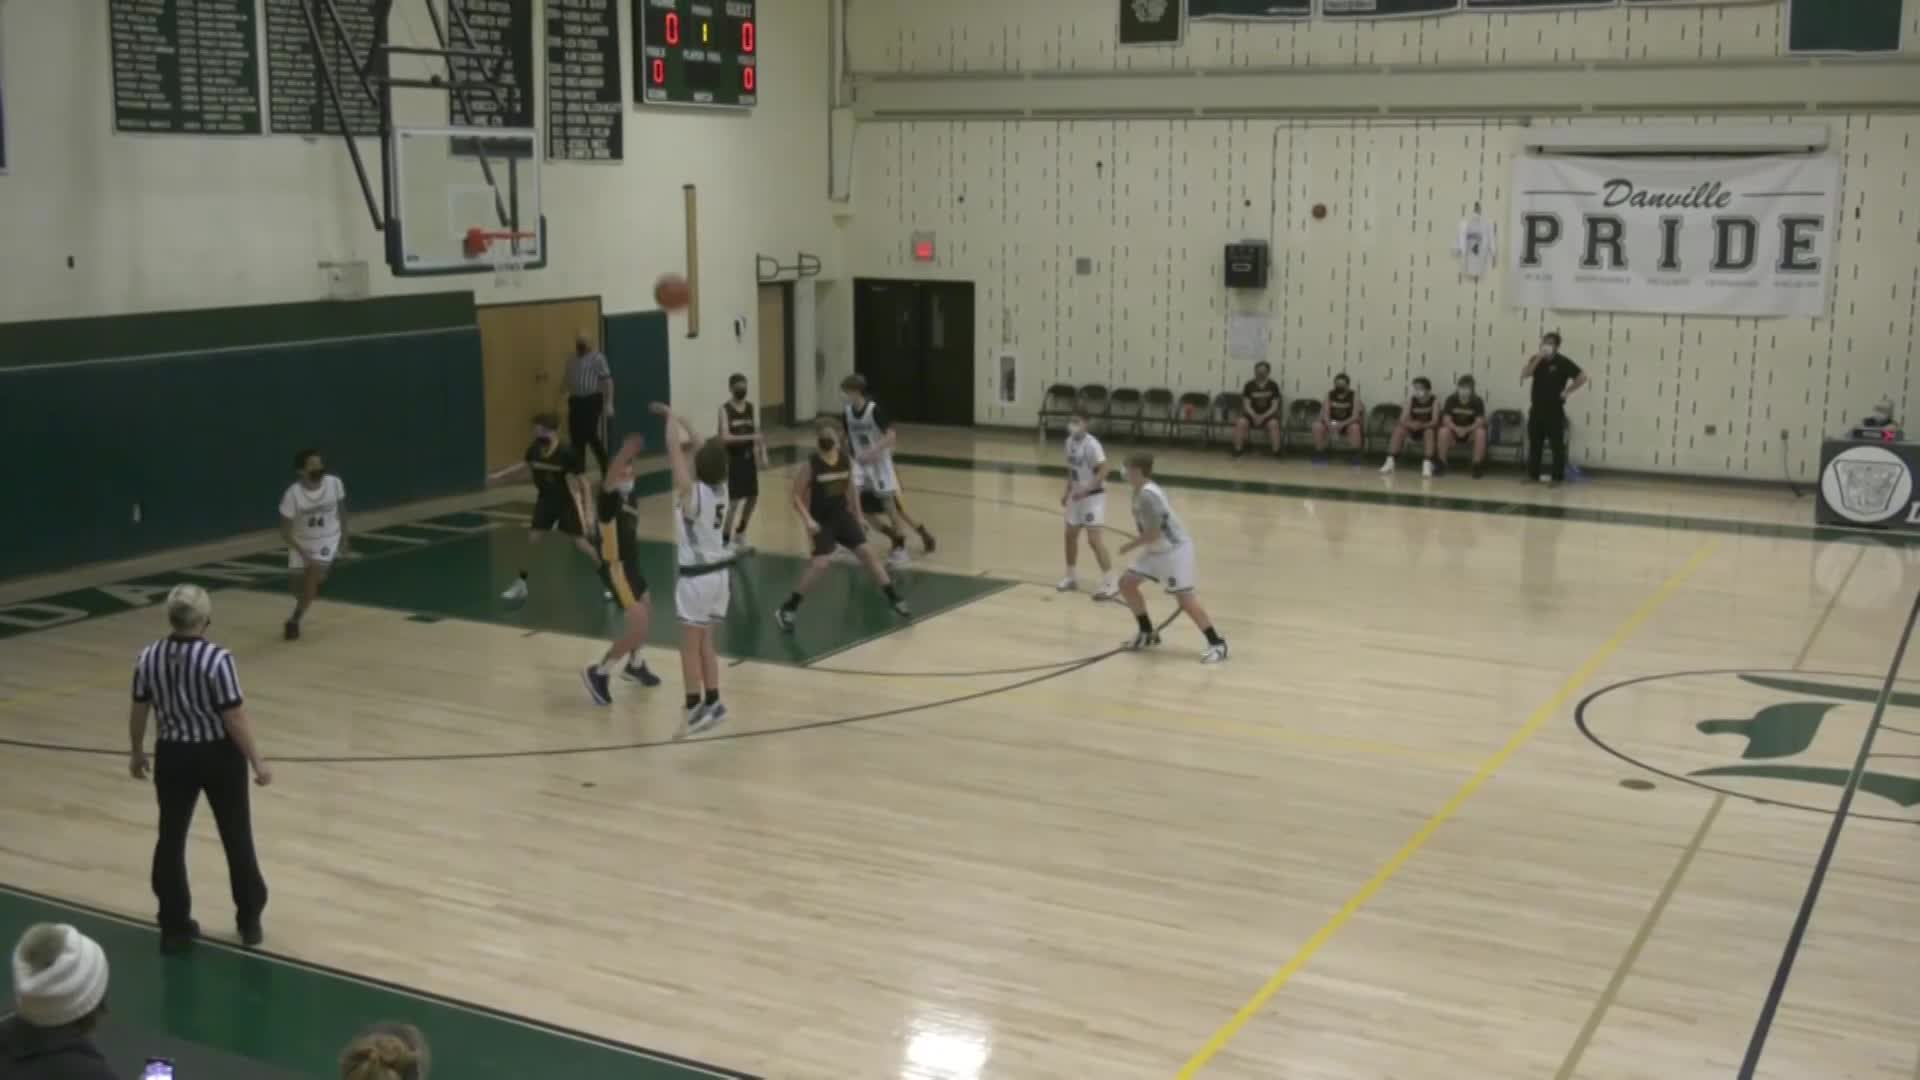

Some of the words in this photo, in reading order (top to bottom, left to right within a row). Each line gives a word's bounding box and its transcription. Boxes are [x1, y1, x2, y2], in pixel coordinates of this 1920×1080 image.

[665, 12, 679, 46] 0
[742, 22, 754, 53] 0
[653, 59, 664, 84] 0
[743, 66, 754, 91] 0
[1602, 178, 1732, 209] Danville
[1519, 210, 1825, 274] PRIDE
